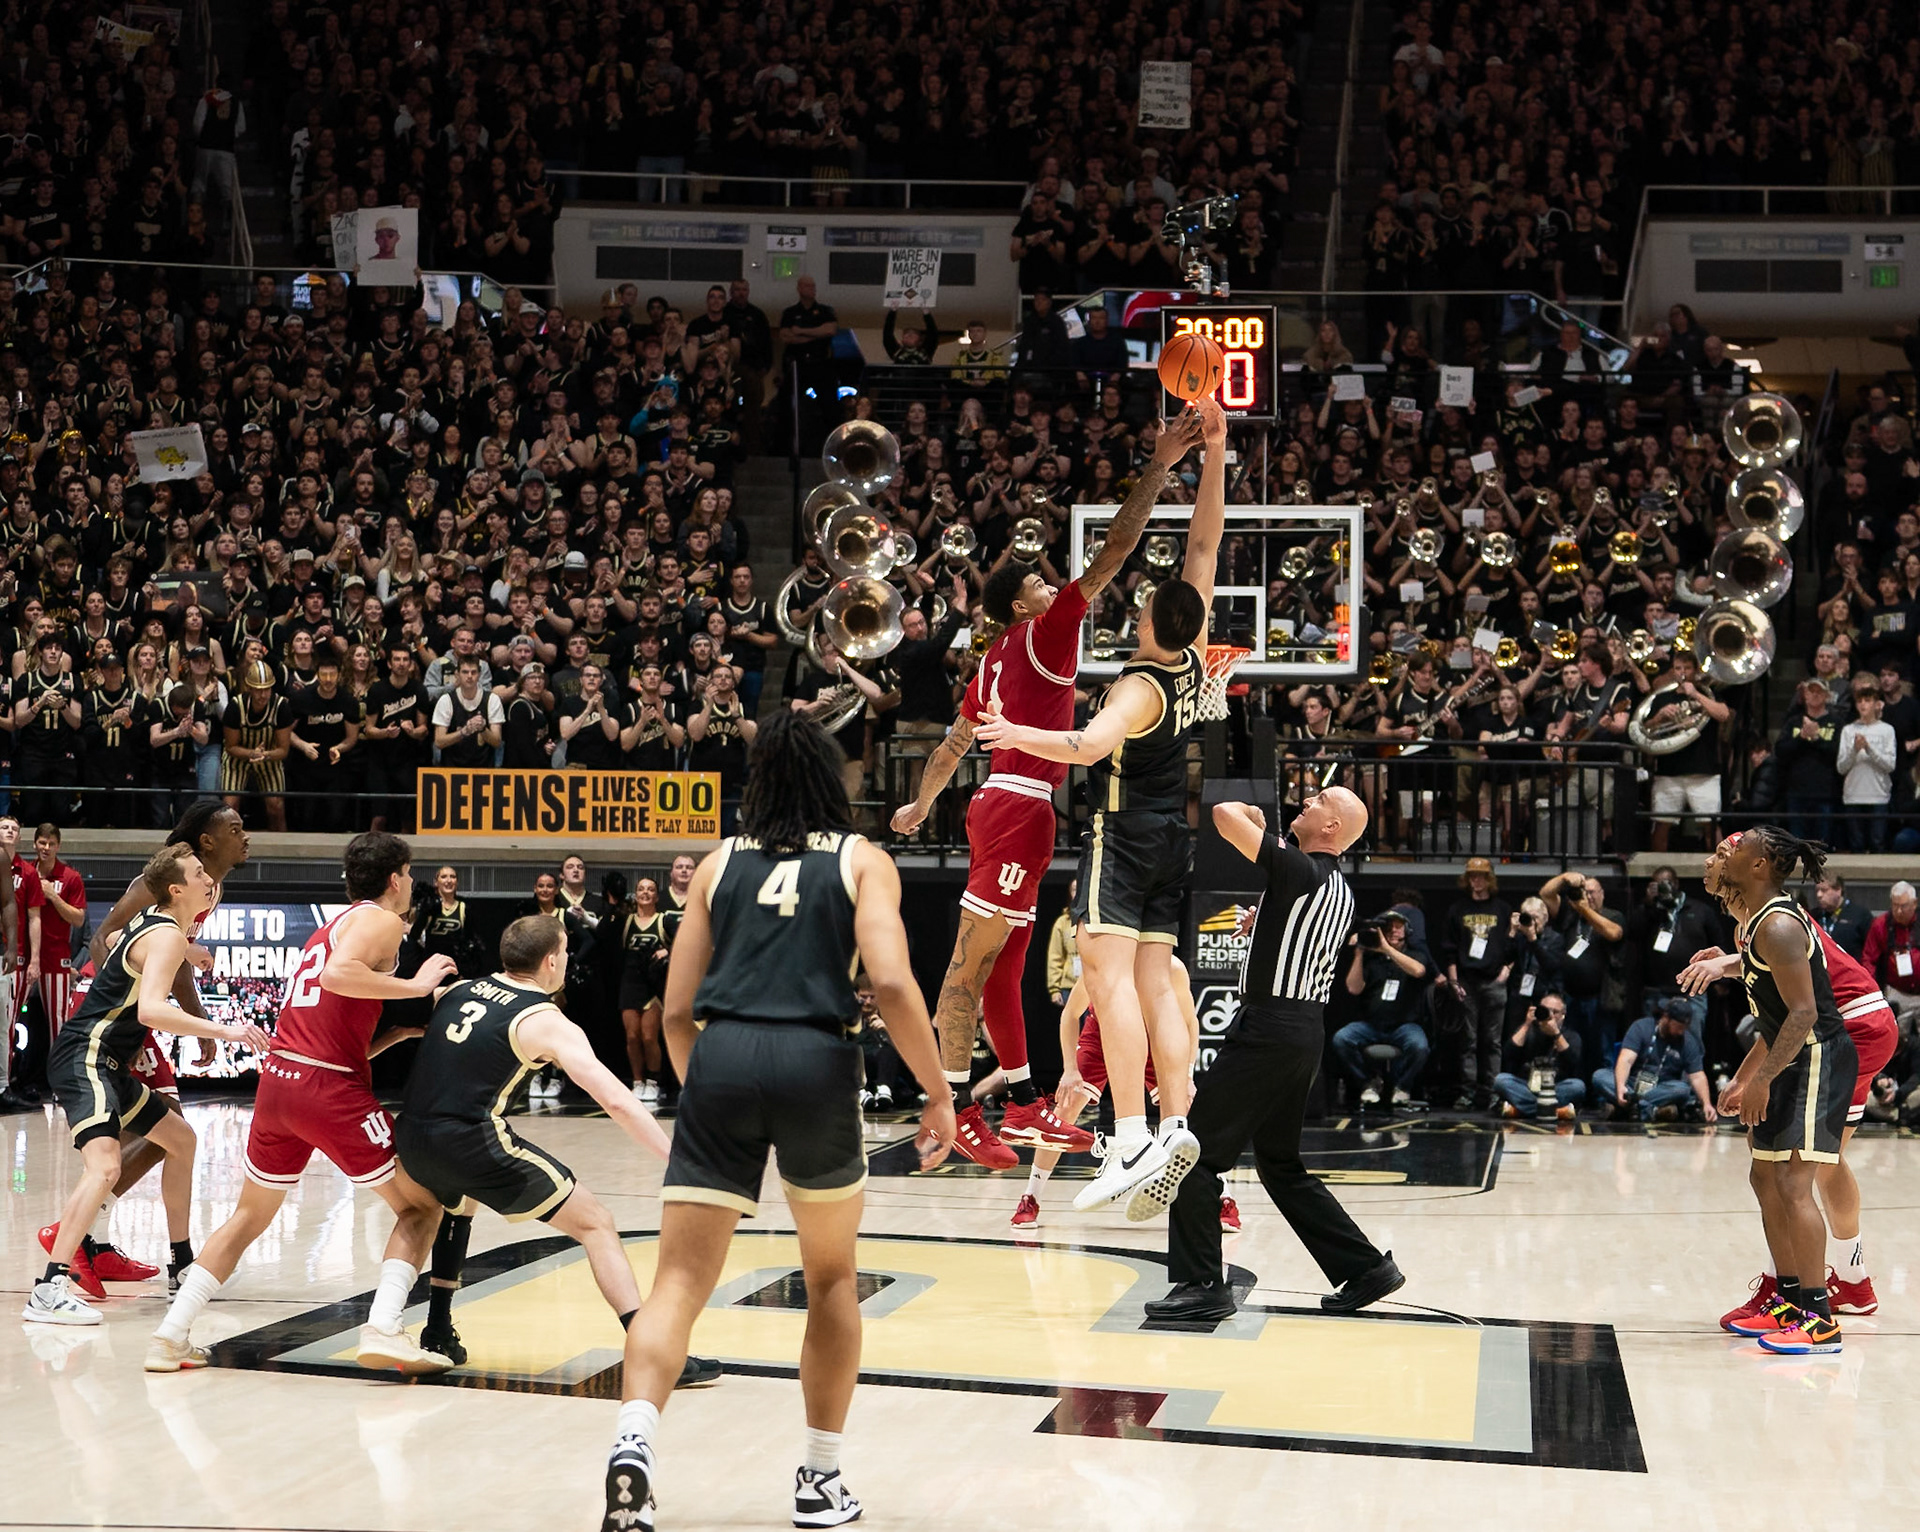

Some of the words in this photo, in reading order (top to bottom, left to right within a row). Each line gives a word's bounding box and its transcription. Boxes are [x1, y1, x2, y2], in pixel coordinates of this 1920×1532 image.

[621, 225, 641, 237] THE
[646, 226, 680, 237] PAINT
[685, 227, 718, 238] CREW
[776, 237, 797, 247] 4-5
[891, 249, 924, 262] WARE
[926, 249, 940, 262] IN
[892, 262, 935, 276] MARCH
[901, 275, 922, 288] IU?
[1174, 317, 1264, 349] 20:00
[42, 709, 59, 730] 11
[1173, 688, 1198, 738] 15
[106, 727, 121, 748] 11
[168, 742, 185, 762] 11
[591, 775, 650, 802] LIVES
[421, 772, 588, 833] DEFENSE
[591, 805, 650, 833] HERE
[655, 818, 682, 834] PLAY
[687, 819, 716, 834] HARD
[757, 859, 803, 917] 4
[997, 861, 1029, 896] IU
[249, 909, 286, 941] TO
[1198, 933, 1250, 948] PURD
[283, 942, 327, 1008] 2
[1198, 961, 1233, 970] CREDIT
[470, 980, 518, 1006] SMITH
[445, 1000, 488, 1044] 3
[360, 1110, 392, 1149] IU
